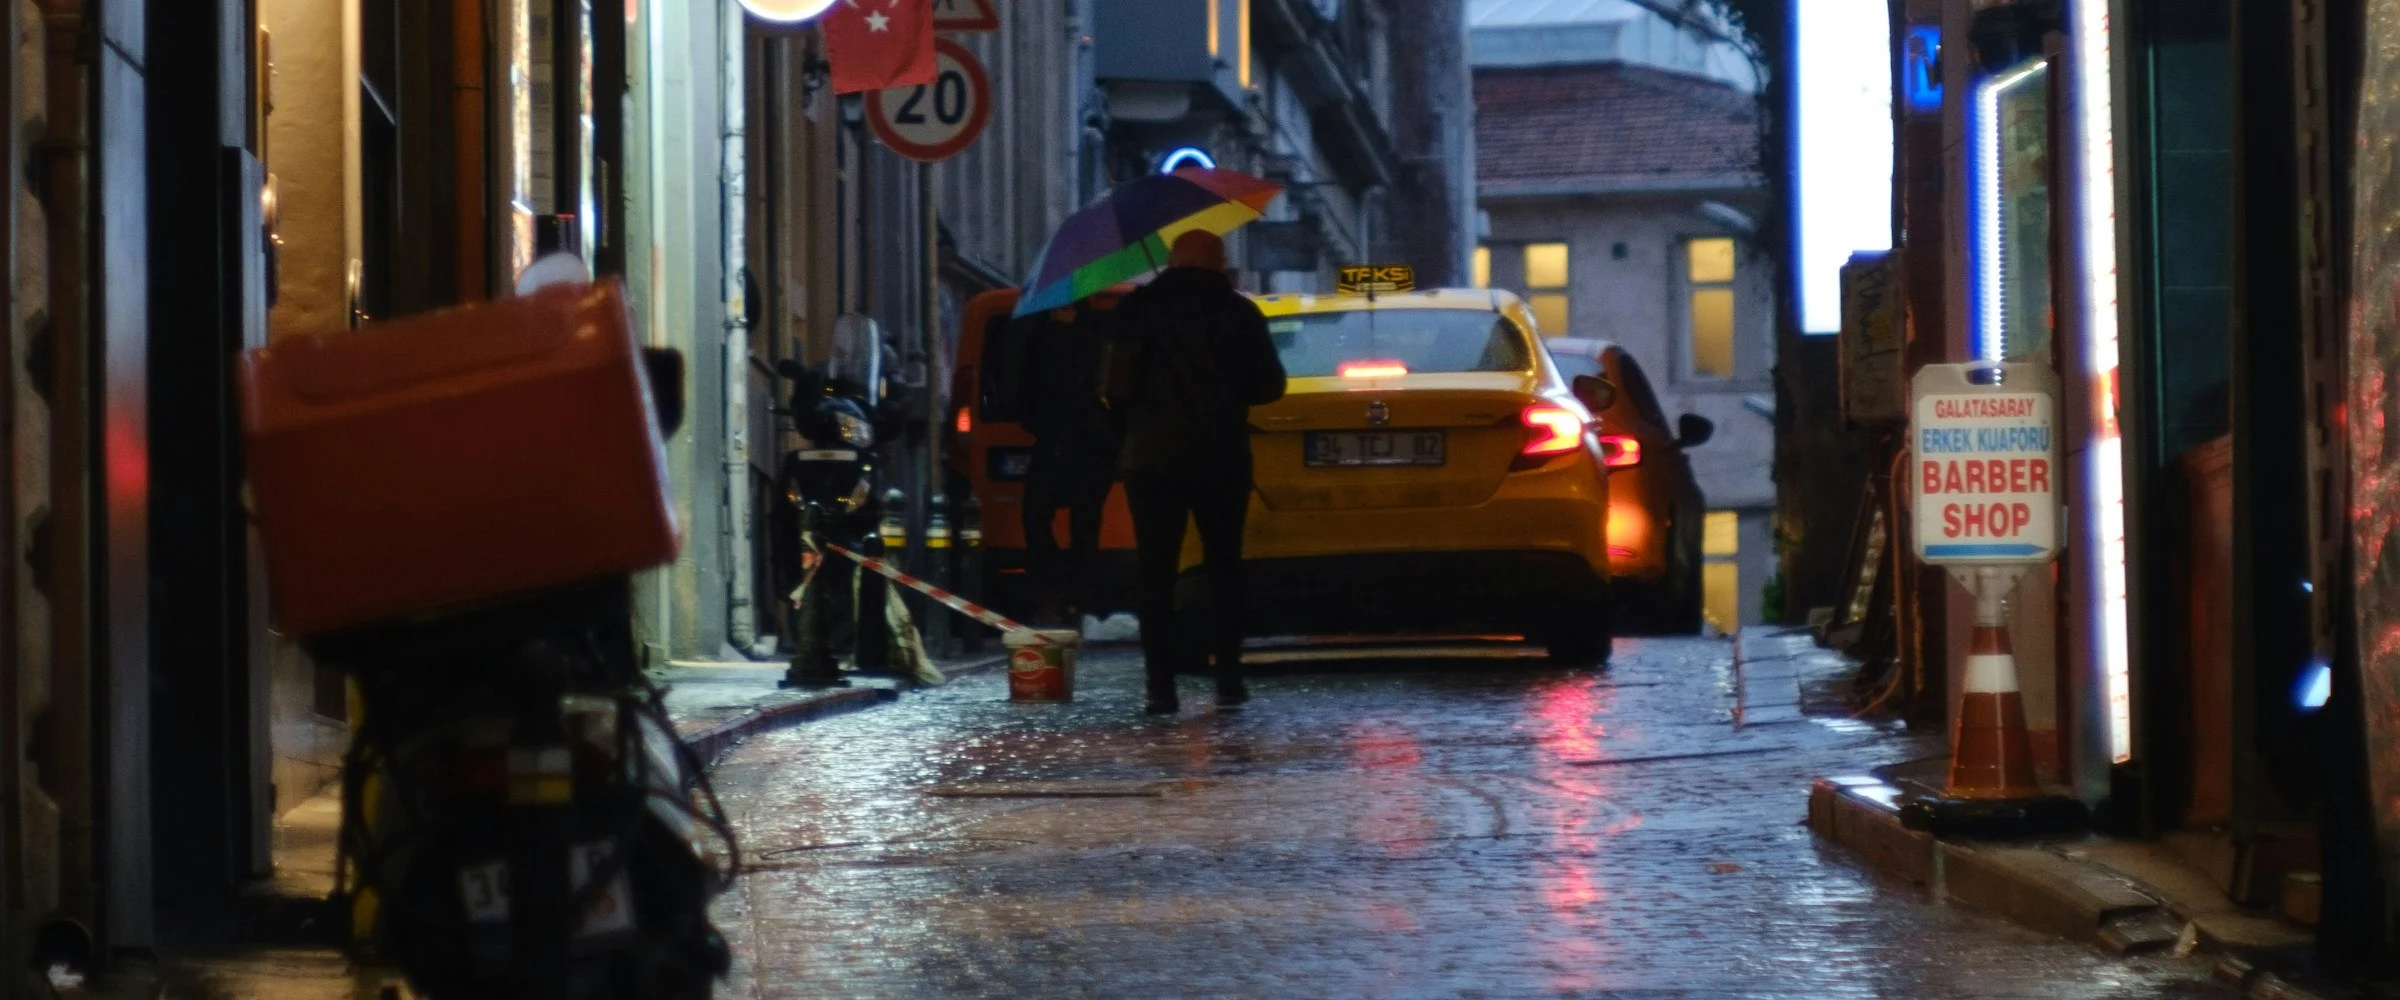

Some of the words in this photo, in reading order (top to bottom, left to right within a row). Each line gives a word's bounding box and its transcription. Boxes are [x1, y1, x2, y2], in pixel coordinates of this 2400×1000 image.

[895, 70, 966, 125] 20
[1935, 398, 2035, 419] GALATASARAY
[1319, 434, 1342, 457] 34
[1922, 428, 1972, 453] ERKEK
[1922, 458, 2049, 494] BARBER
[1943, 502, 2031, 538] SHOP
